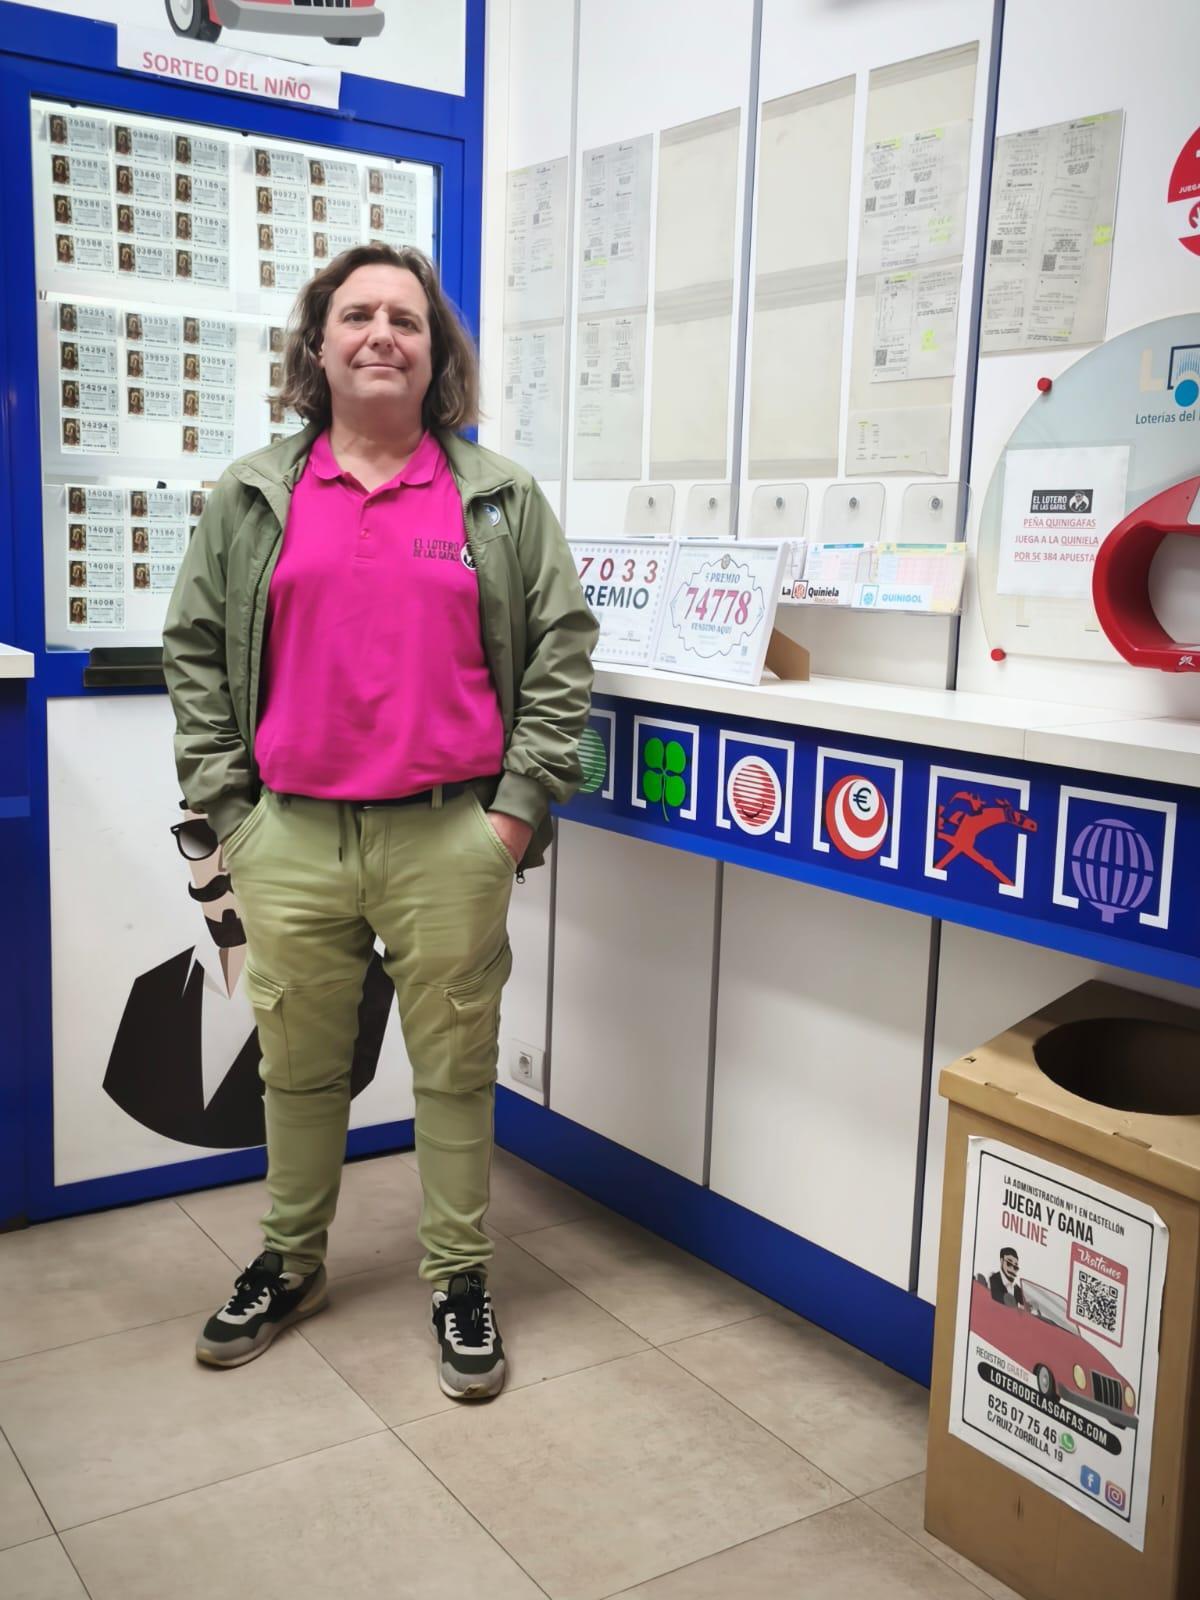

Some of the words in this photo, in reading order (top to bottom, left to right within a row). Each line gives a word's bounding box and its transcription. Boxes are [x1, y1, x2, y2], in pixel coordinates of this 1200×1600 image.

[142, 51, 219, 83] SORTEO
[225, 68, 259, 91] DEL
[264, 75, 311, 101] NIÑO
[1179, 409, 1196, 422] del
[1032, 495, 1041, 504] EL
[1042, 495, 1068, 504] LOTERO
[1023, 516, 1044, 527] PEÑA
[1045, 518, 1096, 528] QUINIGAFAS
[1015, 535, 1040, 544] JUEGA
[1041, 536, 1047, 544] A
[1048, 536, 1060, 544] LA
[1060, 536, 1099, 545] QUINIELA
[1014, 551, 1031, 560] POR
[1042, 552, 1058, 561] 384
[1060, 552, 1096, 562] APUESTA
[710, 572, 741, 585] PREMIO
[584, 585, 650, 610] REMIO
[781, 586, 792, 596] La
[808, 586, 840, 598] Quiniela
[882, 593, 922, 604] QUINIGOL
[684, 587, 752, 626] 74778
[1002, 1188, 1042, 1222] JUEGA
[1046, 1206, 1055, 1226] Y
[1058, 1212, 1094, 1246] GANA
[1004, 1175, 1012, 1185] LA
[1012, 1178, 1065, 1209] ADMINISTRACIÓN
[1079, 1208, 1088, 1219] EN
[1088, 1211, 1125, 1237] CASTELLÓN
[1002, 1210, 1048, 1248] ONLINE
[976, 1346, 1006, 1370] REGISTRO
[988, 1394, 1008, 1416] 625
[1010, 1405, 1024, 1423] 07
[1027, 1416, 1040, 1435] 75
[1044, 1426, 1057, 1444] 46
[990, 1369, 1108, 1446] LOTERODELASGAFAS.COM
[987, 1410, 1013, 1434] C/RUIZ
[1054, 1450, 1064, 1462] 19
